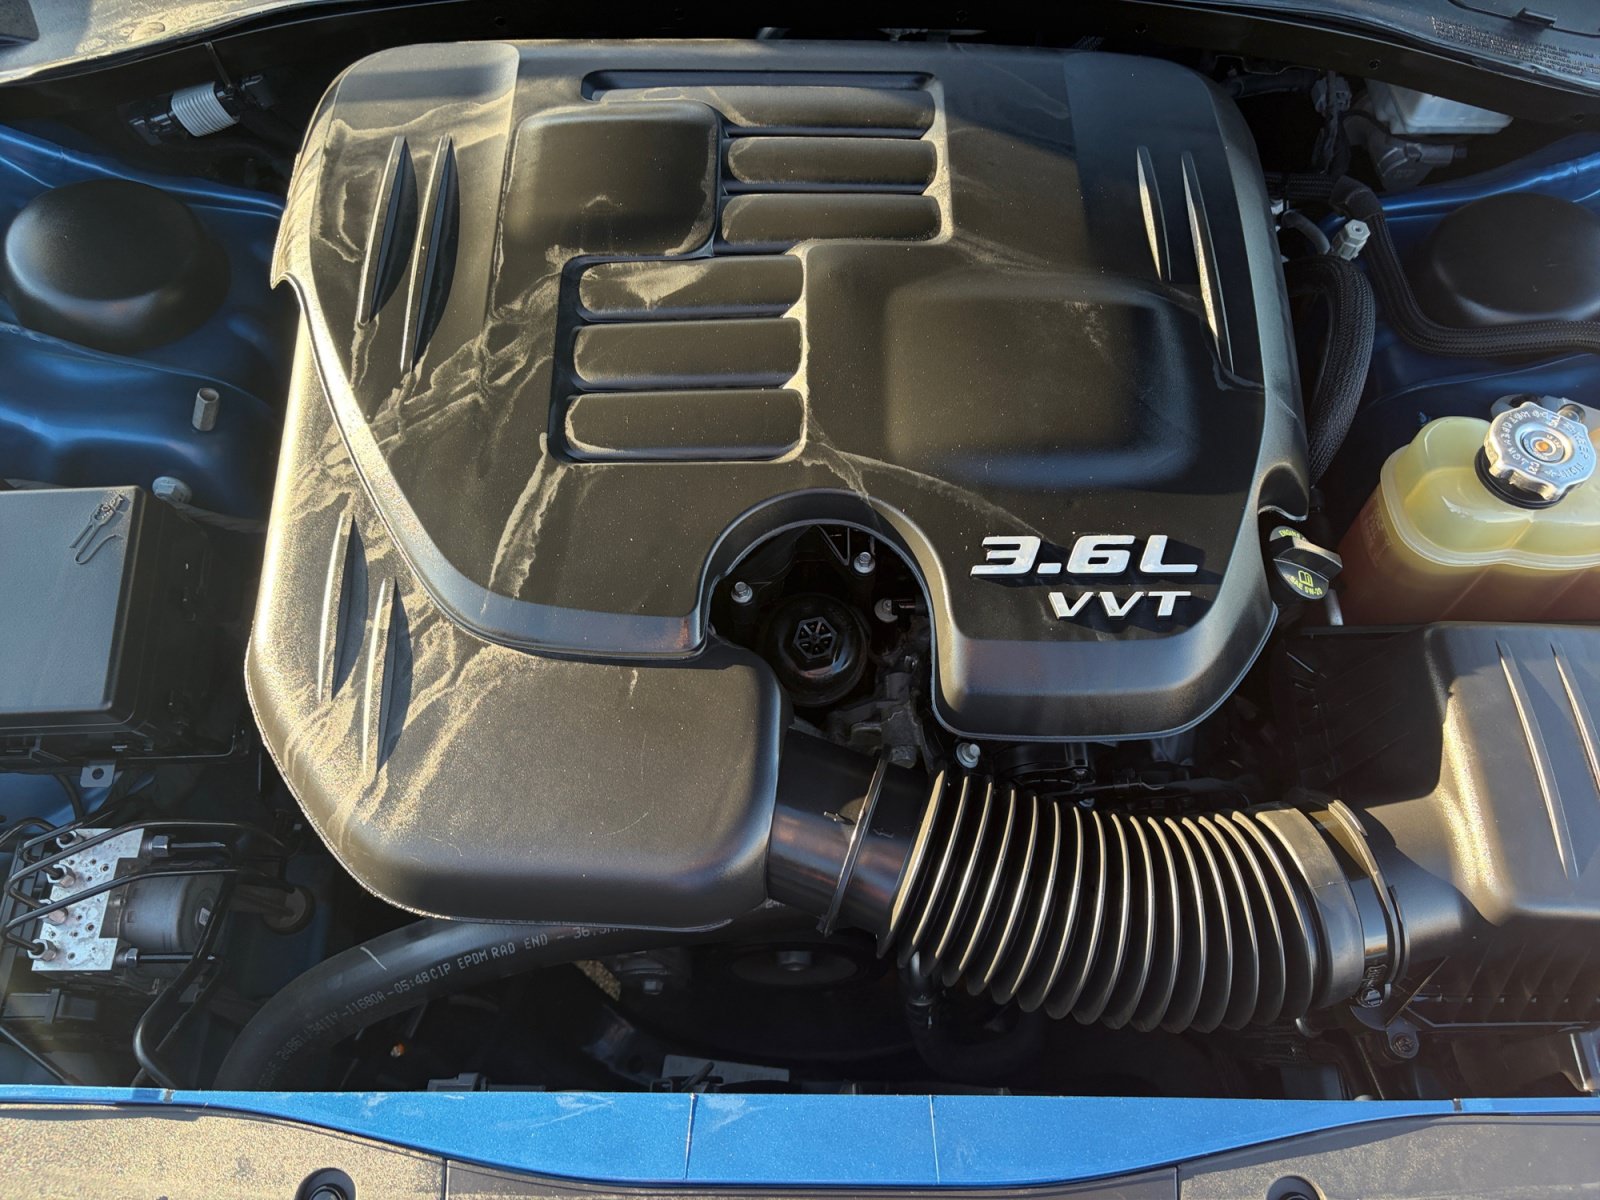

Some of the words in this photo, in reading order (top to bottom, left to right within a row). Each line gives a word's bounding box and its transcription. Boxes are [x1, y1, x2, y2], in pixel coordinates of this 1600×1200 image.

[970, 535, 1198, 576] 3.6L
[1048, 591, 1191, 619] VVT
[457, 950, 488, 970] EPDM
[524, 933, 548, 949] END
